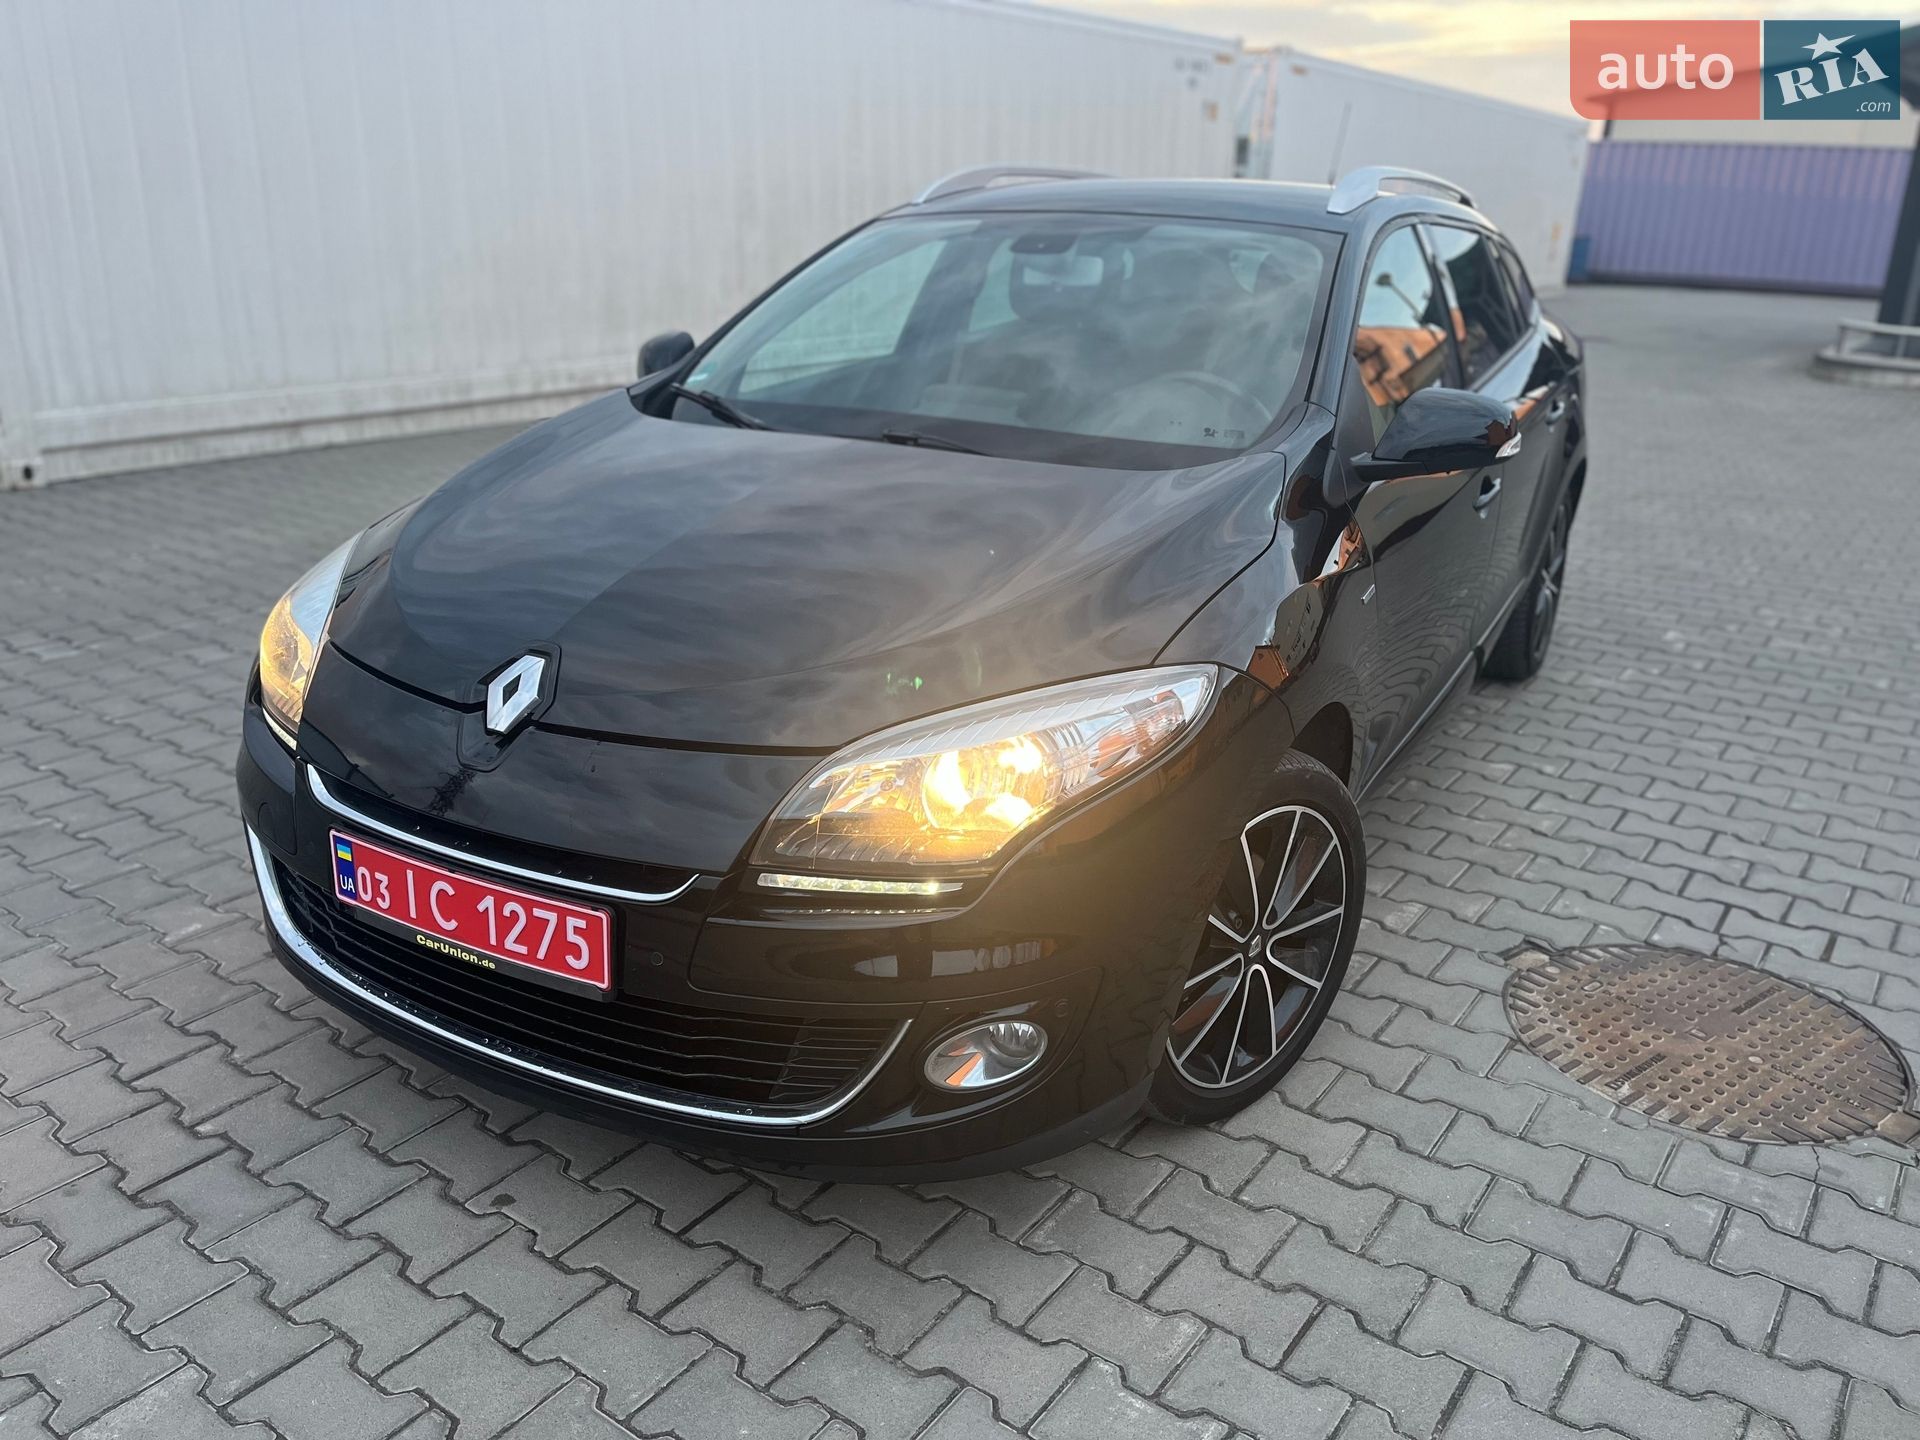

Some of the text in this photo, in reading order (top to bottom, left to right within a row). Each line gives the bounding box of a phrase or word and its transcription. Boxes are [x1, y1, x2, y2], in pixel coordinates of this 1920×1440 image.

[340, 874, 355, 894] UA
[357, 866, 391, 910] 03
[476, 895, 590, 970] 1275
[416, 934, 496, 969] CarUnion.de
